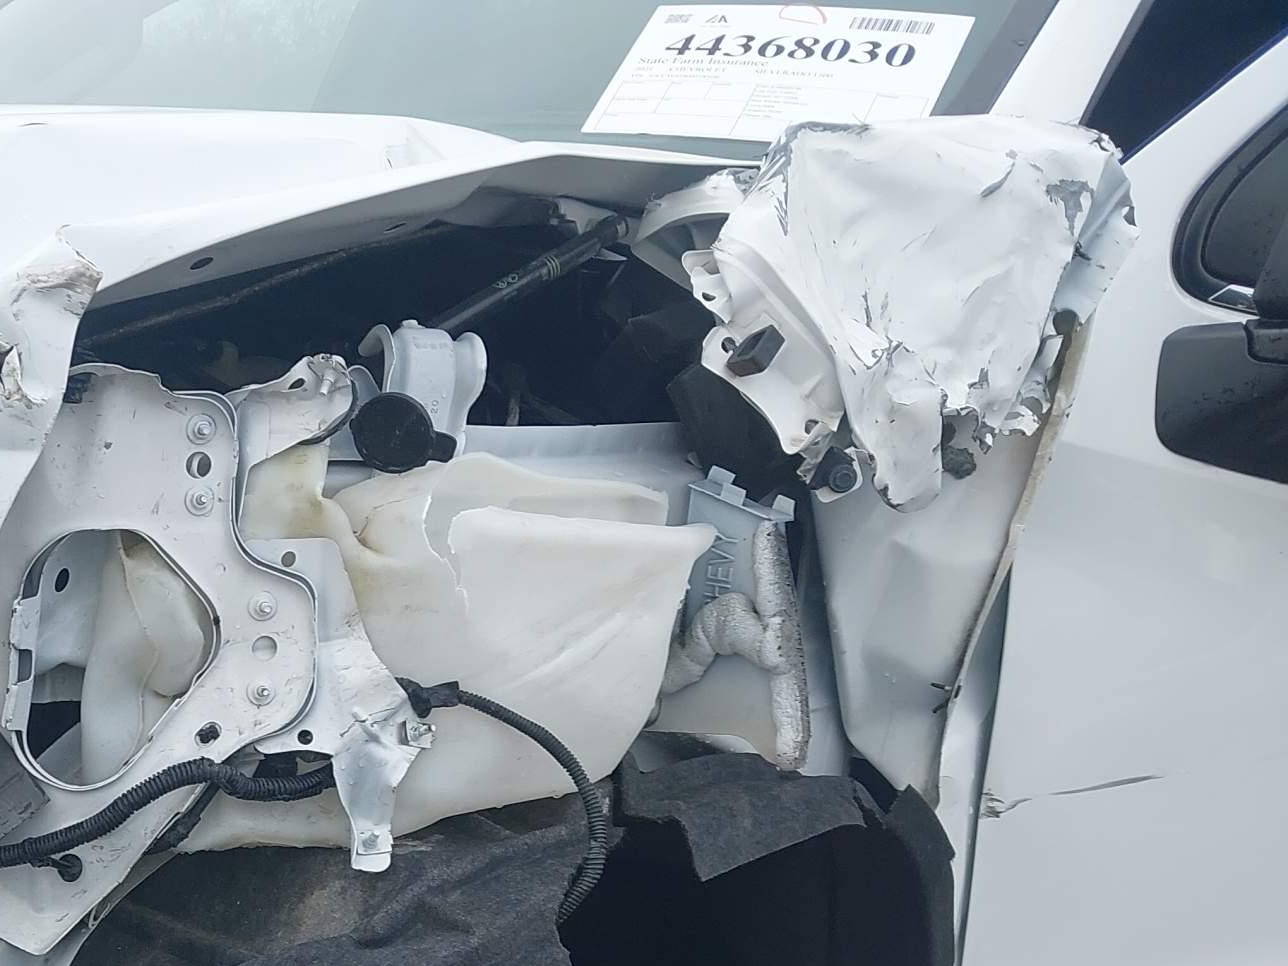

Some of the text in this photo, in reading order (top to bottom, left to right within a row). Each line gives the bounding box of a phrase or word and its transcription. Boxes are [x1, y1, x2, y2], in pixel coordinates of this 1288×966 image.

[638, 56, 769, 67] State Farm Insurance
[664, 33, 917, 68] 44368030
[703, 532, 740, 605] HEVY
